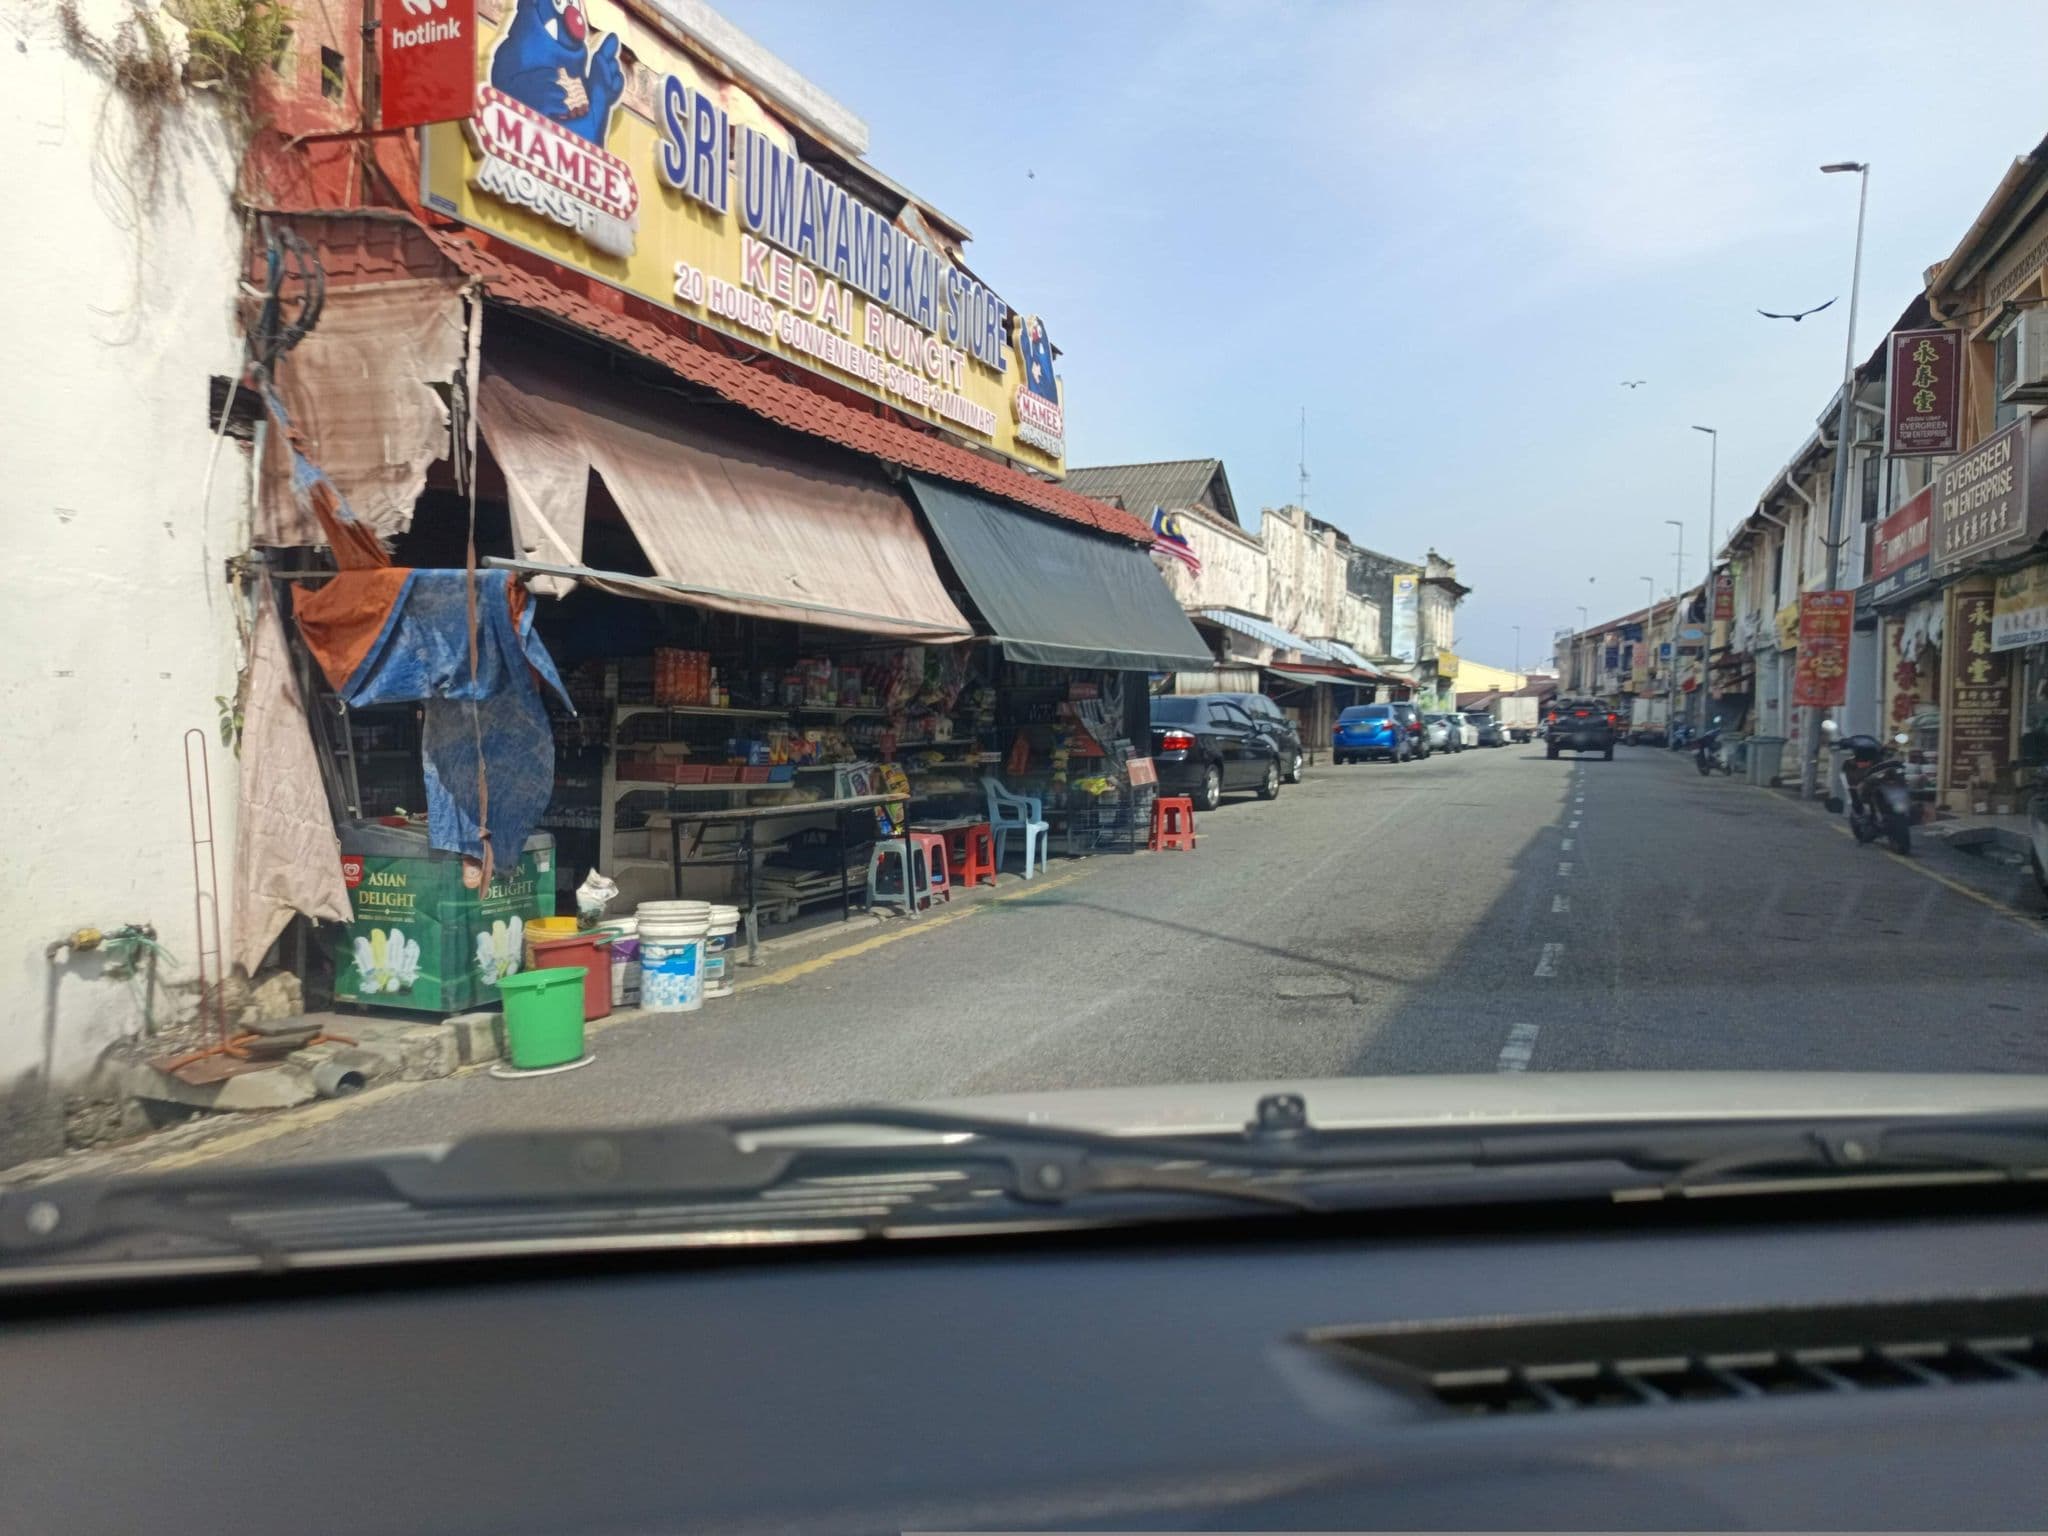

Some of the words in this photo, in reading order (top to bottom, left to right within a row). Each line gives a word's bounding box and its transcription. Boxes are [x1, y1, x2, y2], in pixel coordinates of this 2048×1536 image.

[392, 17, 461, 49] hotlink
[495, 108, 626, 202] MAMEE
[479, 157, 635, 255] MONST
[659, 74, 728, 214] SRI
[742, 125, 940, 333] UMAYAMBIKAI
[946, 266, 1008, 372] STORE
[742, 234, 853, 335] KEDAI
[865, 302, 965, 389] RUNCIT
[675, 261, 703, 304] 20
[709, 276, 775, 336] HOURS
[778, 311, 885, 387] CONVENIENCE
[887, 363, 929, 407] STORE
[943, 390, 997, 437] MINIMART
[1022, 395, 1060, 432] MAMEE
[1900, 421, 1948, 430] EVERGREEN
[1943, 495, 1959, 524] TCM
[1960, 466, 2013, 515] ENTERPRISE
[1945, 435, 2011, 496] EVERGREEN
[359, 890, 416, 908] DELIGHT
[368, 872, 407, 887] ASIAN
